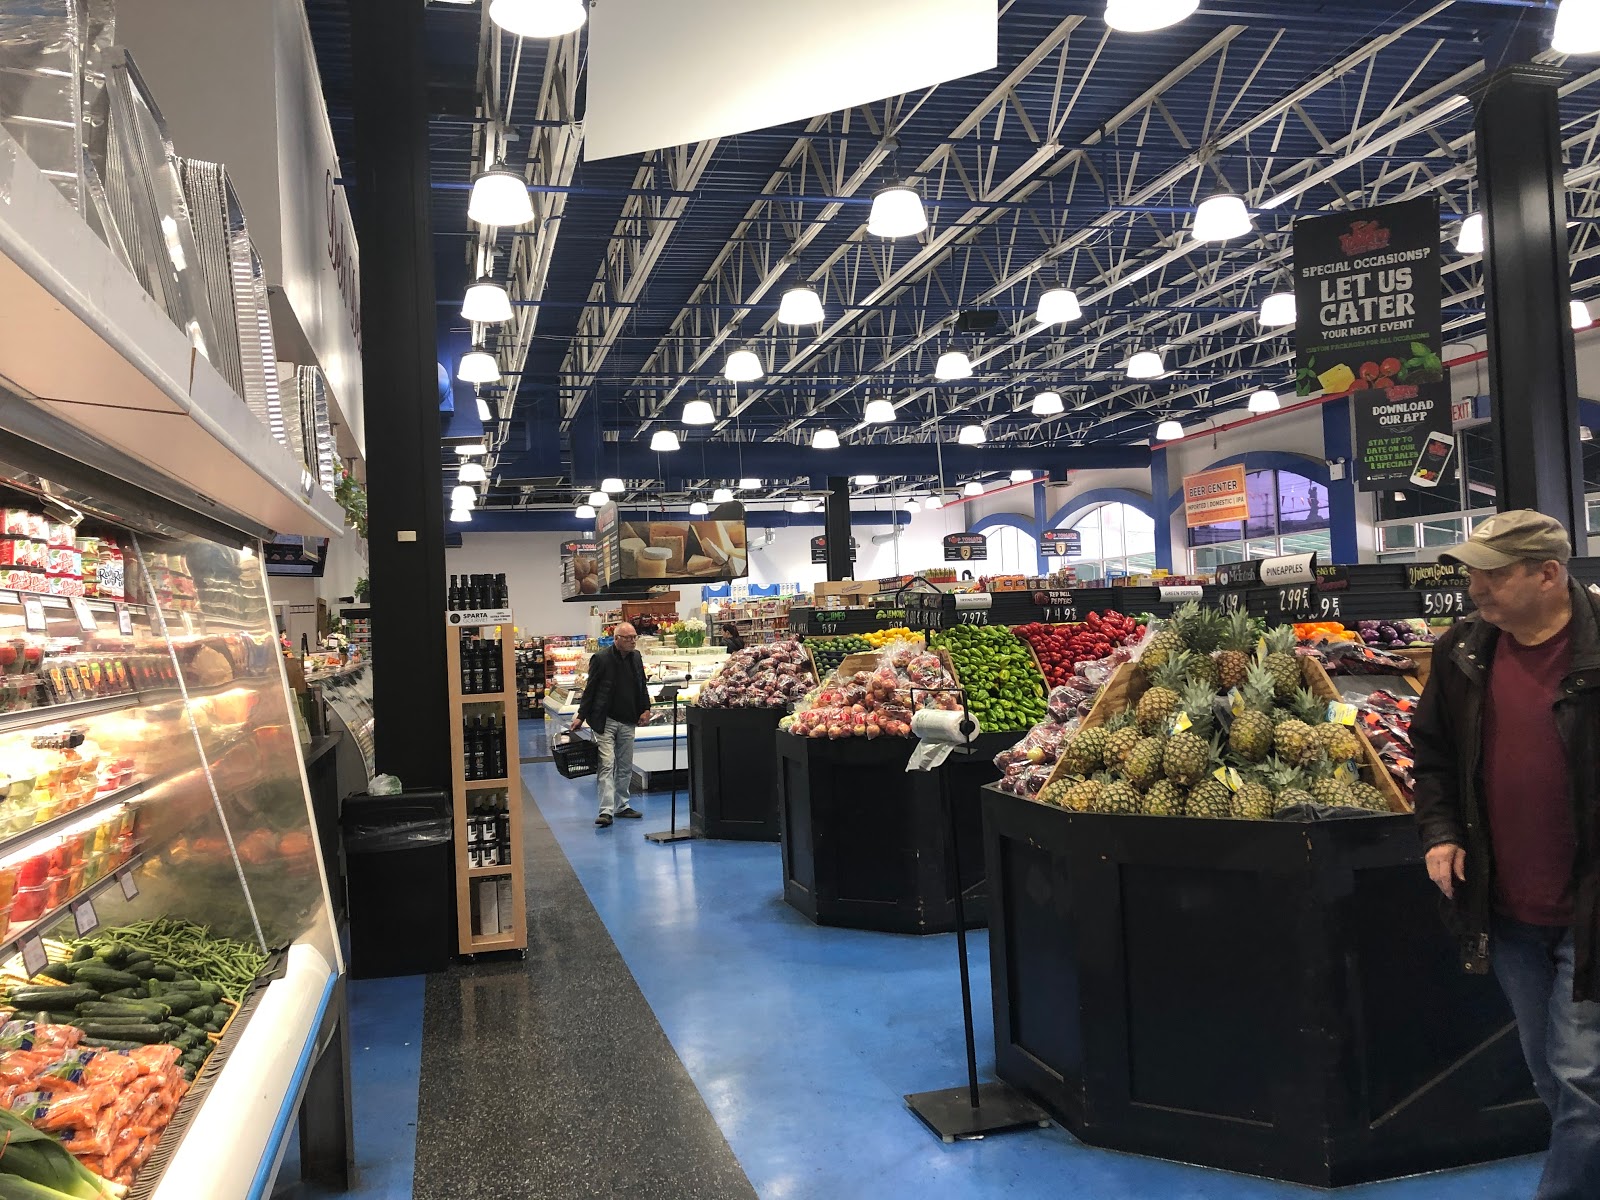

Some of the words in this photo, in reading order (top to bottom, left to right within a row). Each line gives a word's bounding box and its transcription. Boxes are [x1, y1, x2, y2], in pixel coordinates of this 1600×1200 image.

[1302, 261, 1351, 278] SPECIAL
[1354, 247, 1430, 269] OCCASIONS?
[1320, 272, 1371, 303] LET
[1378, 267, 1412, 294] US
[1319, 293, 1416, 327] CATER
[1321, 327, 1348, 340] YOUR
[1350, 323, 1378, 337] NEXT
[1380, 318, 1415, 333] EVENT
[1394, 332, 1430, 342] OCCASIONS
[1372, 400, 1434, 416] DOWNLOAD
[1452, 402, 1470, 421] EXIT
[1379, 414, 1401, 426] OUR
[1403, 411, 1428, 424] APP
[1366, 446, 1387, 455] DATE
[1401, 443, 1415, 451] OUR
[1368, 439, 1388, 447] STAY
[1364, 453, 1393, 463] LATEST
[1395, 451, 1419, 460] SALES
[1376, 460, 1413, 469] SPECIALS
[1189, 486, 1206, 498] BEER
[1208, 480, 1238, 494] CENTER
[1187, 502, 1207, 511] IMPORTED
[1210, 498, 1233, 508] DOMESTIC
[963, 549, 968, 557] 2
[1266, 564, 1303, 576] PINEAPPLES
[1425, 578, 1470, 587] POTATOES
[1050, 597, 1073, 605] PEPPERS
